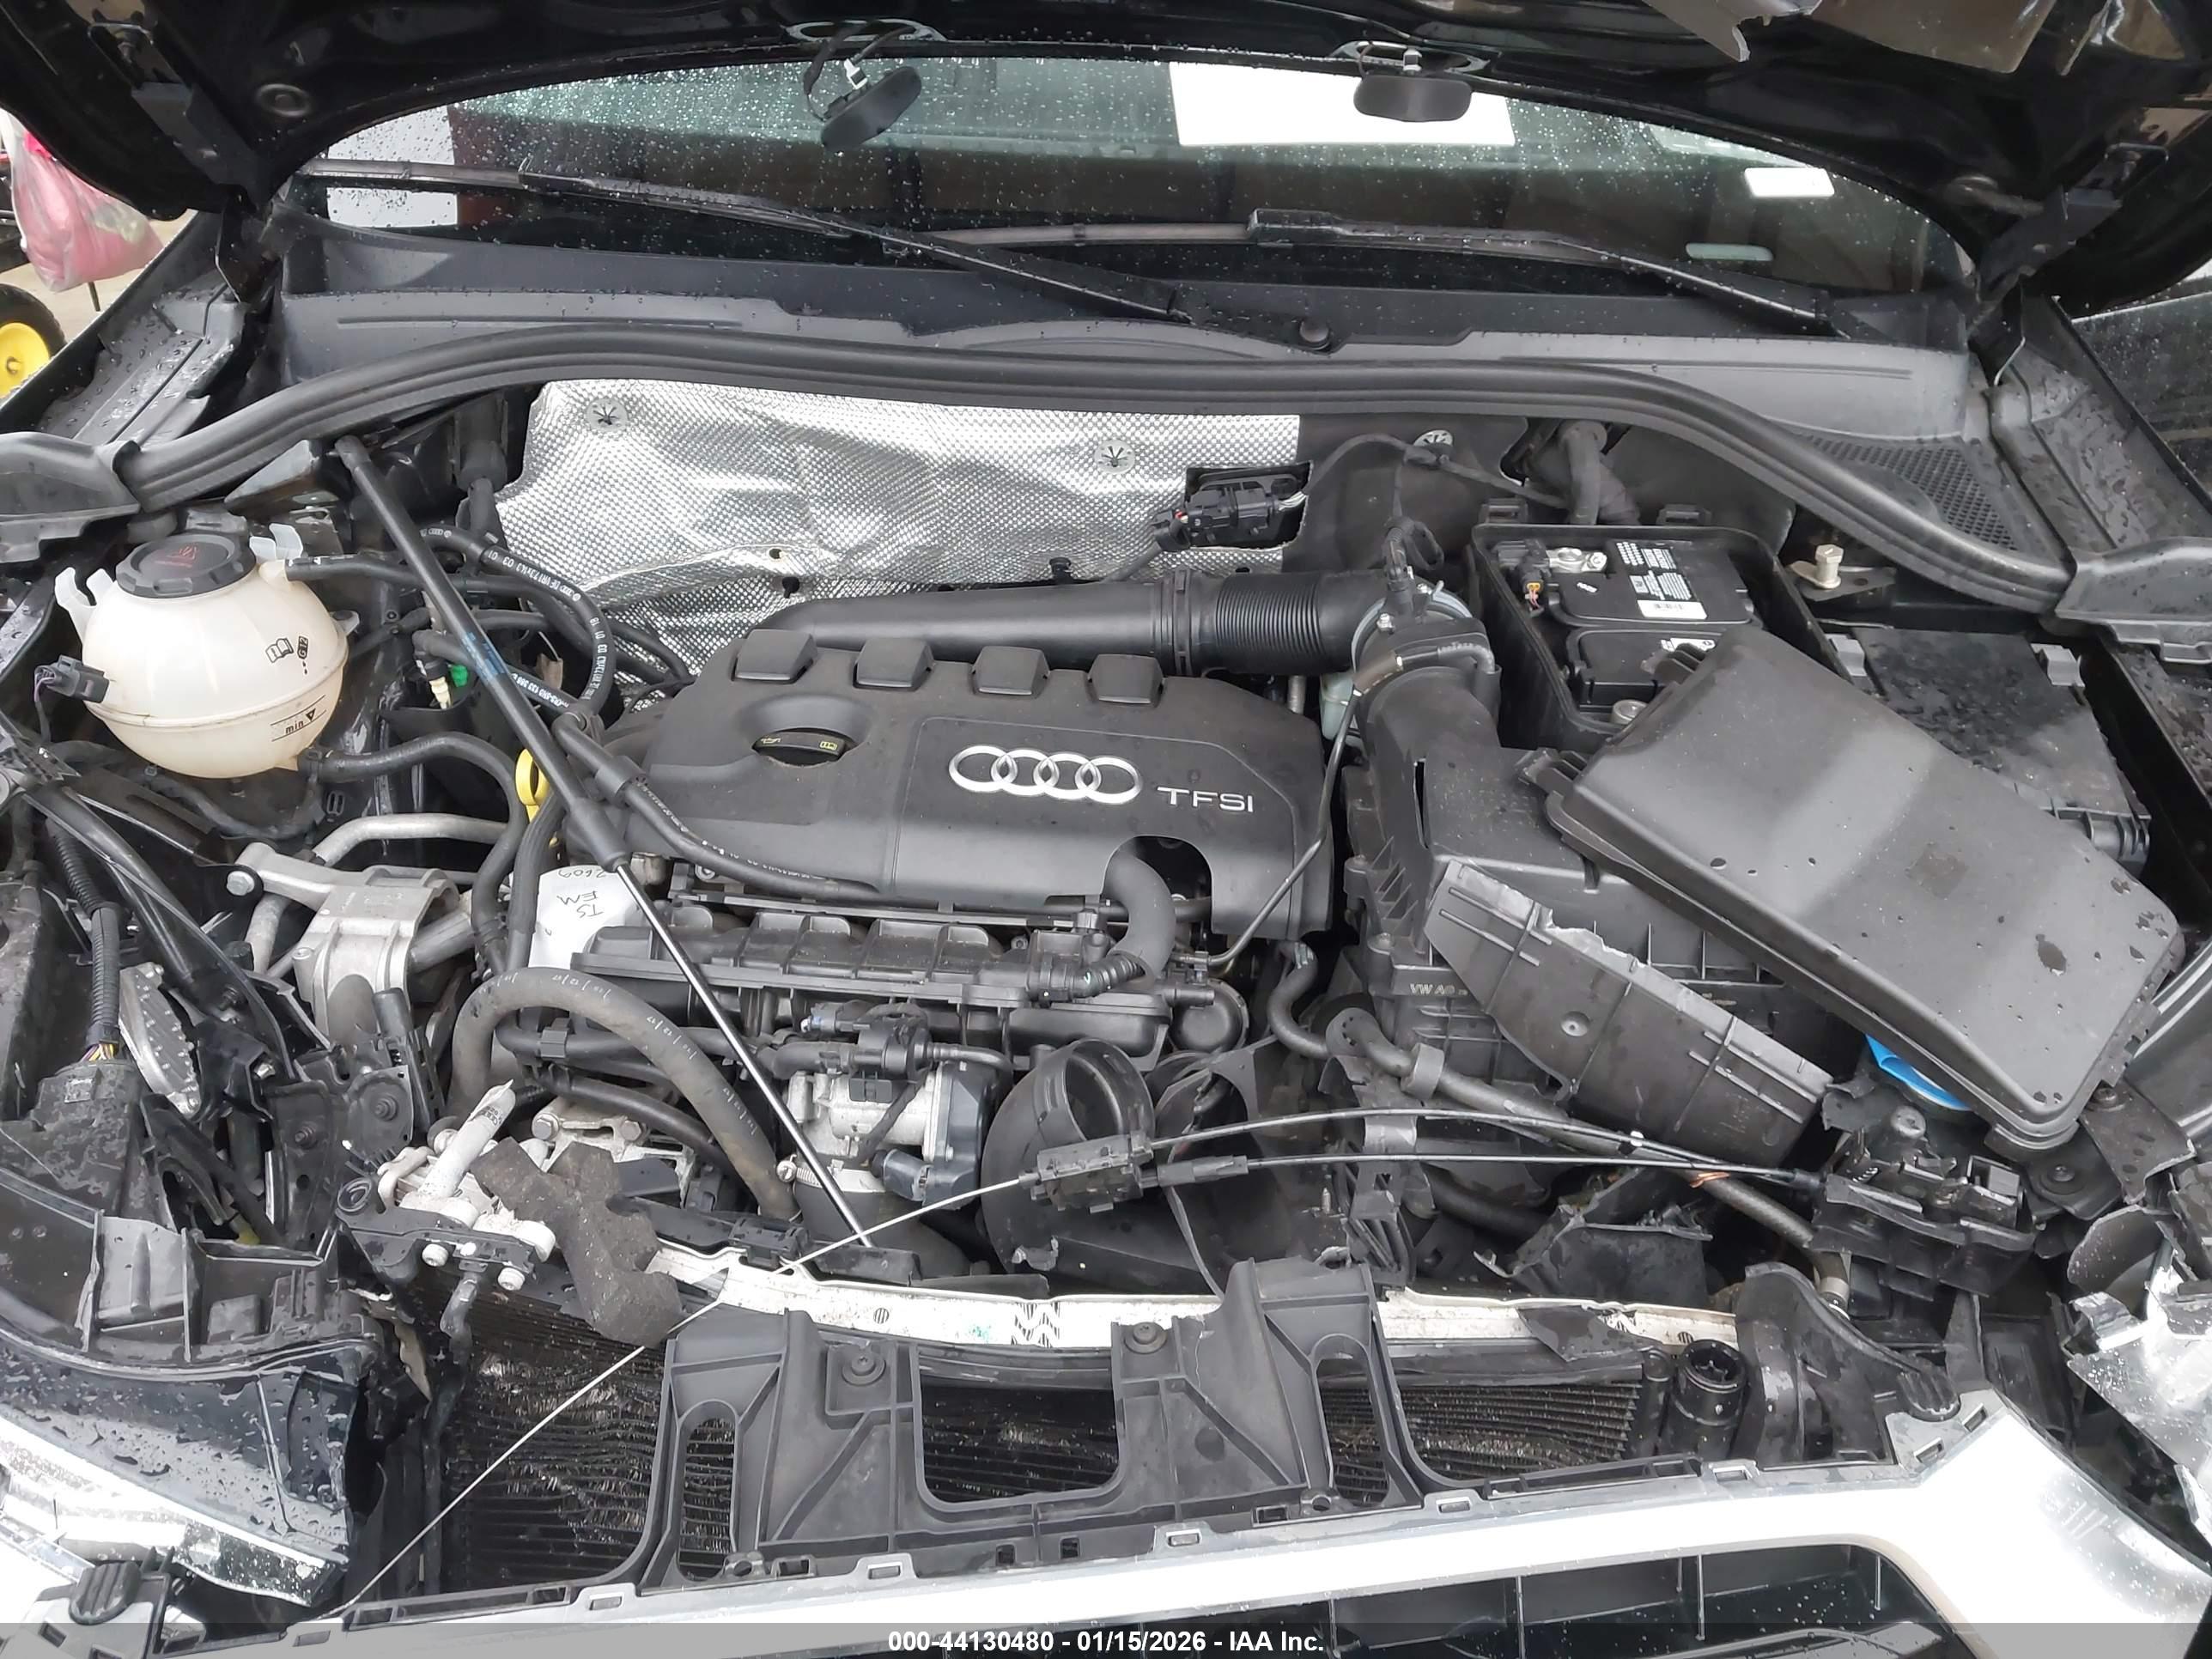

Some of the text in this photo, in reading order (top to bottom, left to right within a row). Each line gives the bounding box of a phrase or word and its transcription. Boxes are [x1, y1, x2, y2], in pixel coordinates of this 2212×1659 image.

[502, 556, 514, 568] 03
[285, 720, 304, 734] min
[1157, 786, 1254, 812] TFSI
[1409, 983, 1433, 995] VW
